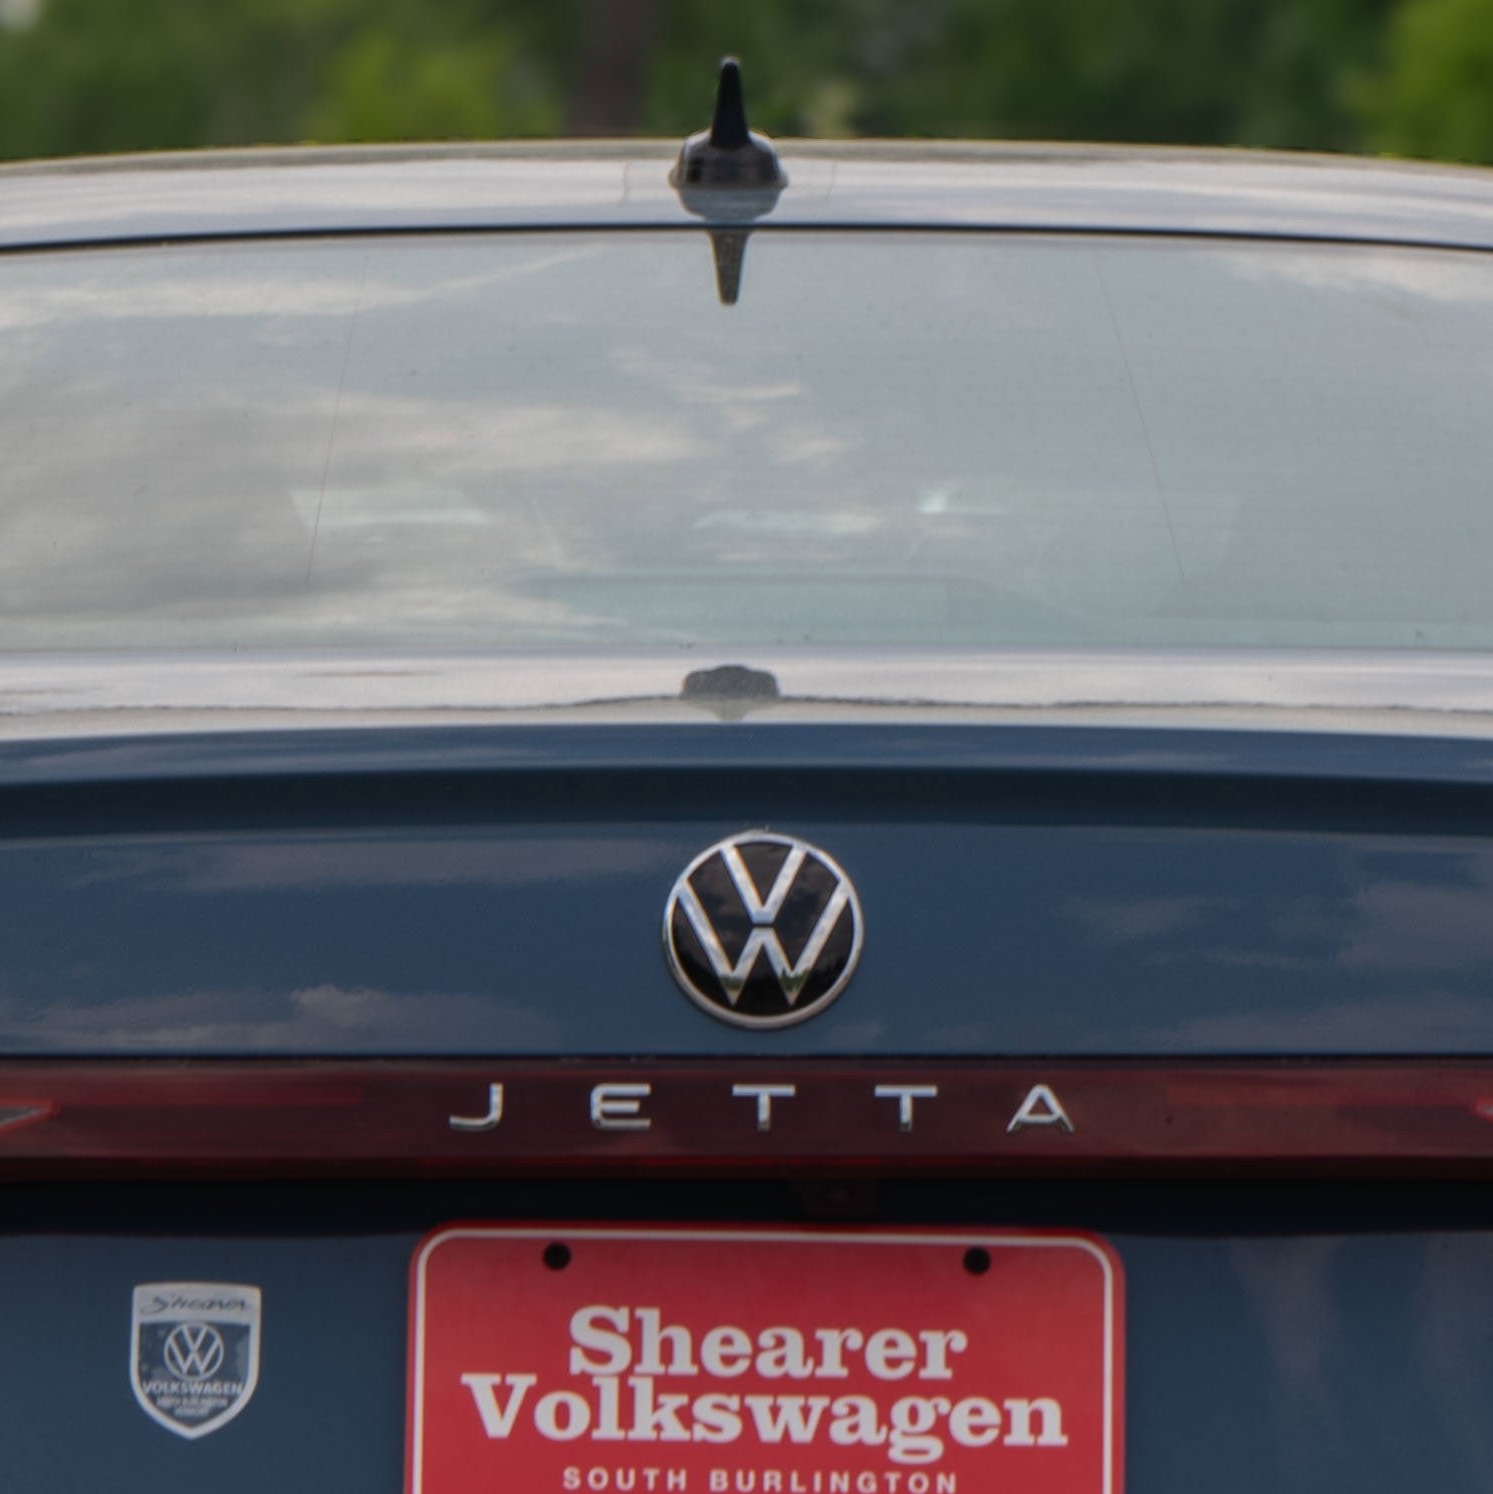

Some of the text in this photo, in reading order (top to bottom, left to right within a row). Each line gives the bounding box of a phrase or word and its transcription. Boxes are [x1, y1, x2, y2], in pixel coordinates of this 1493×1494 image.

[669, 836, 860, 1018] VW
[449, 1082, 1076, 1133] JETTA
[568, 1305, 968, 1381] Shearer
[461, 1373, 1070, 1464] Volkswagen
[562, 1467, 689, 1494] SOUTH
